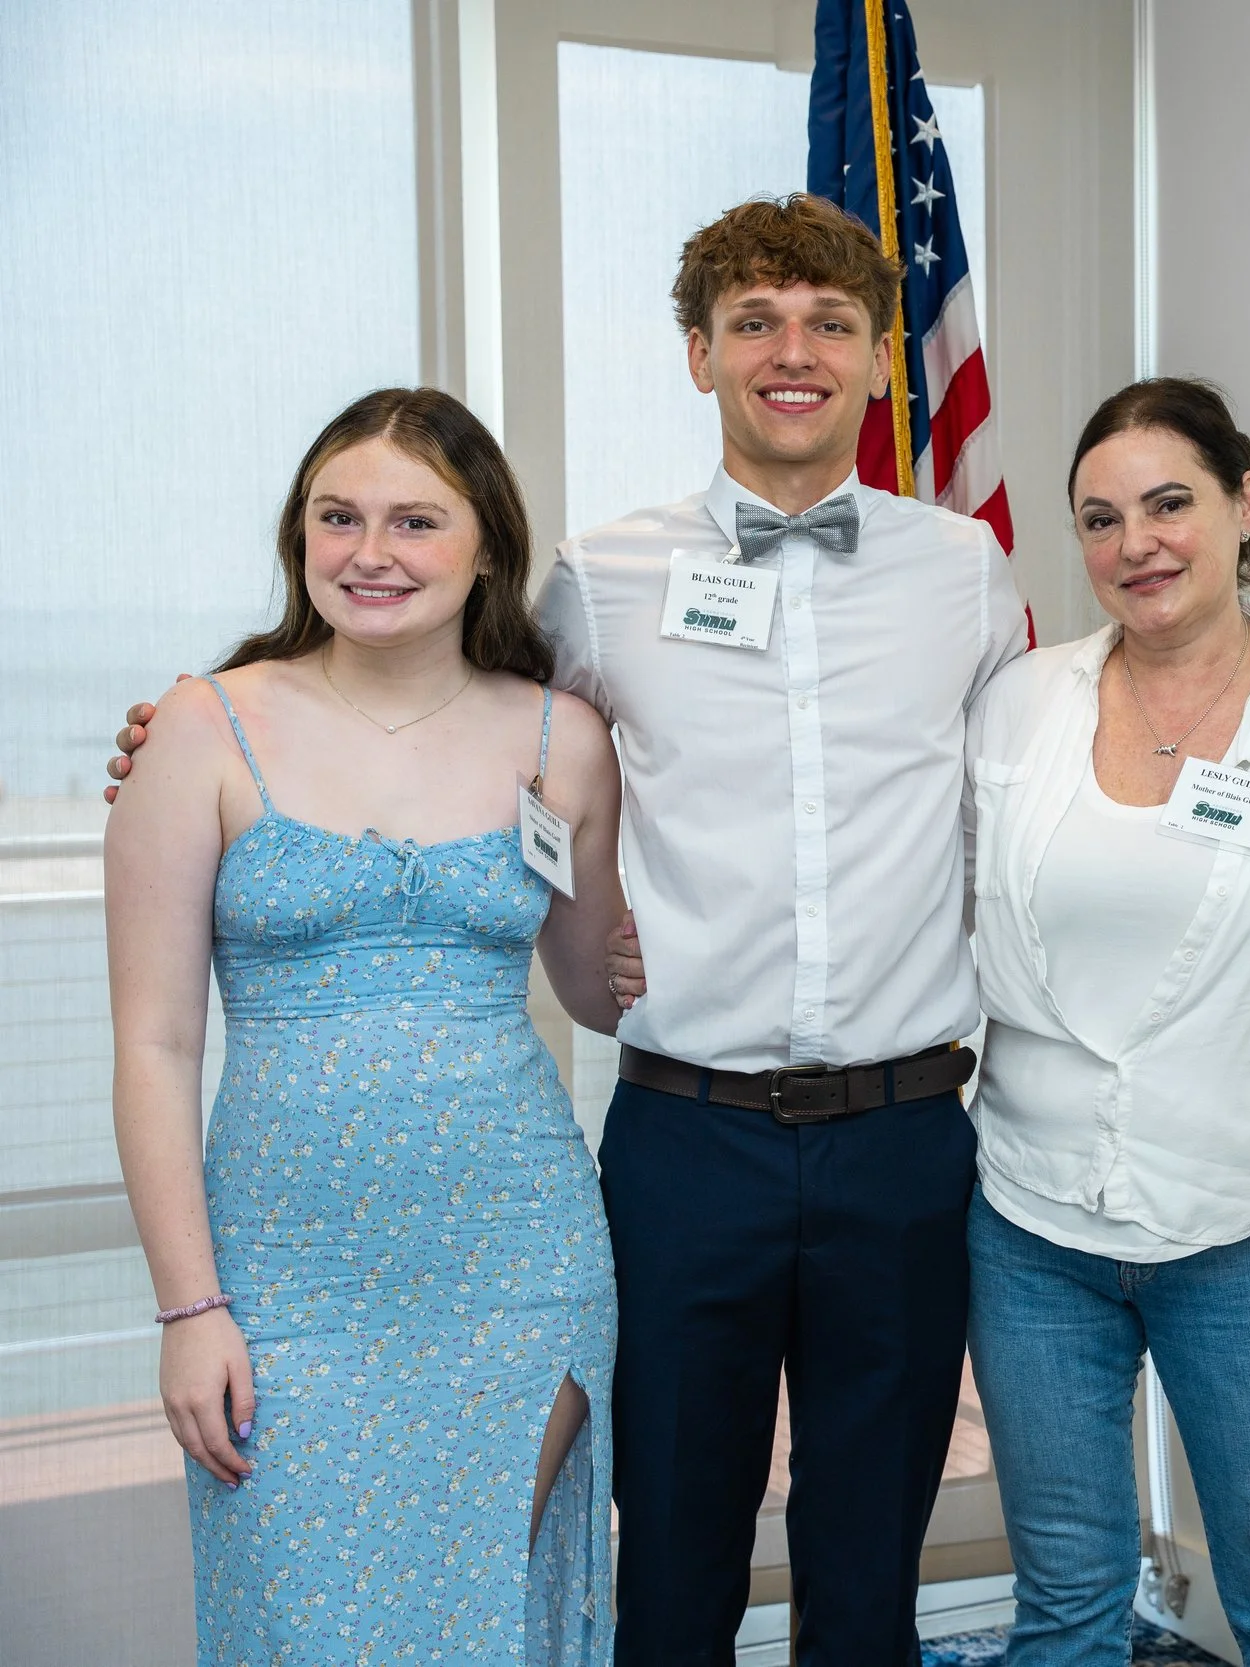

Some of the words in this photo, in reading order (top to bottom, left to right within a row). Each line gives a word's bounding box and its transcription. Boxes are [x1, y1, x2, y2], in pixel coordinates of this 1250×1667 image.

[692, 572, 722, 584] BLAIS
[724, 577, 756, 590] GUILL
[704, 592, 717, 600] 12th
[718, 596, 738, 604] grade
[683, 608, 737, 631] SHAW
[704, 628, 732, 637] SCHOOL
[1200, 768, 1232, 782] LESLY
[1192, 784, 1215, 795] Mother
[1225, 793, 1241, 802] Blais
[1192, 801, 1242, 825] SHAW
[1210, 820, 1235, 830] SCHOOL
